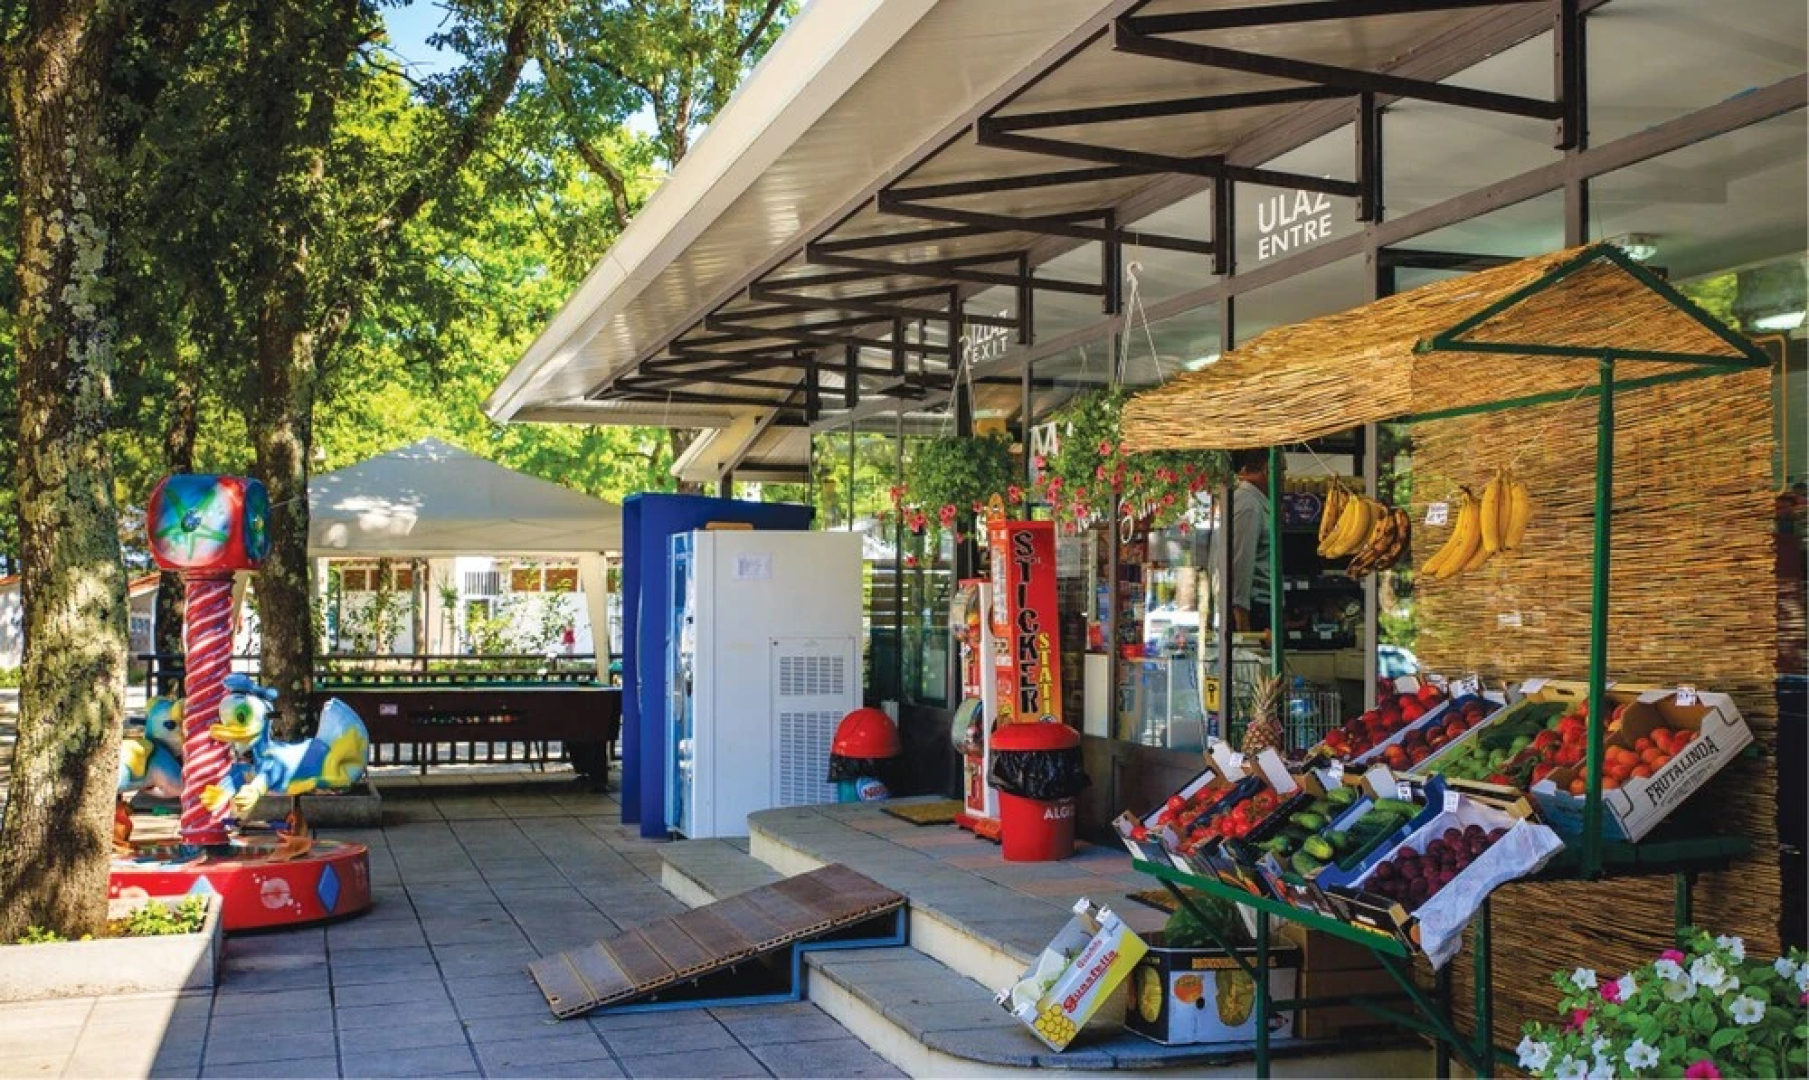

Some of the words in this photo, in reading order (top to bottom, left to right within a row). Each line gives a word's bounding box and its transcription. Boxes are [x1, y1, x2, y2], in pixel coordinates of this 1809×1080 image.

[1258, 213, 1332, 261] ENTRE
[972, 336, 1008, 363] EXIT
[1013, 530, 1040, 714] STICKER
[1644, 735, 1720, 807] FRUTALINDA
